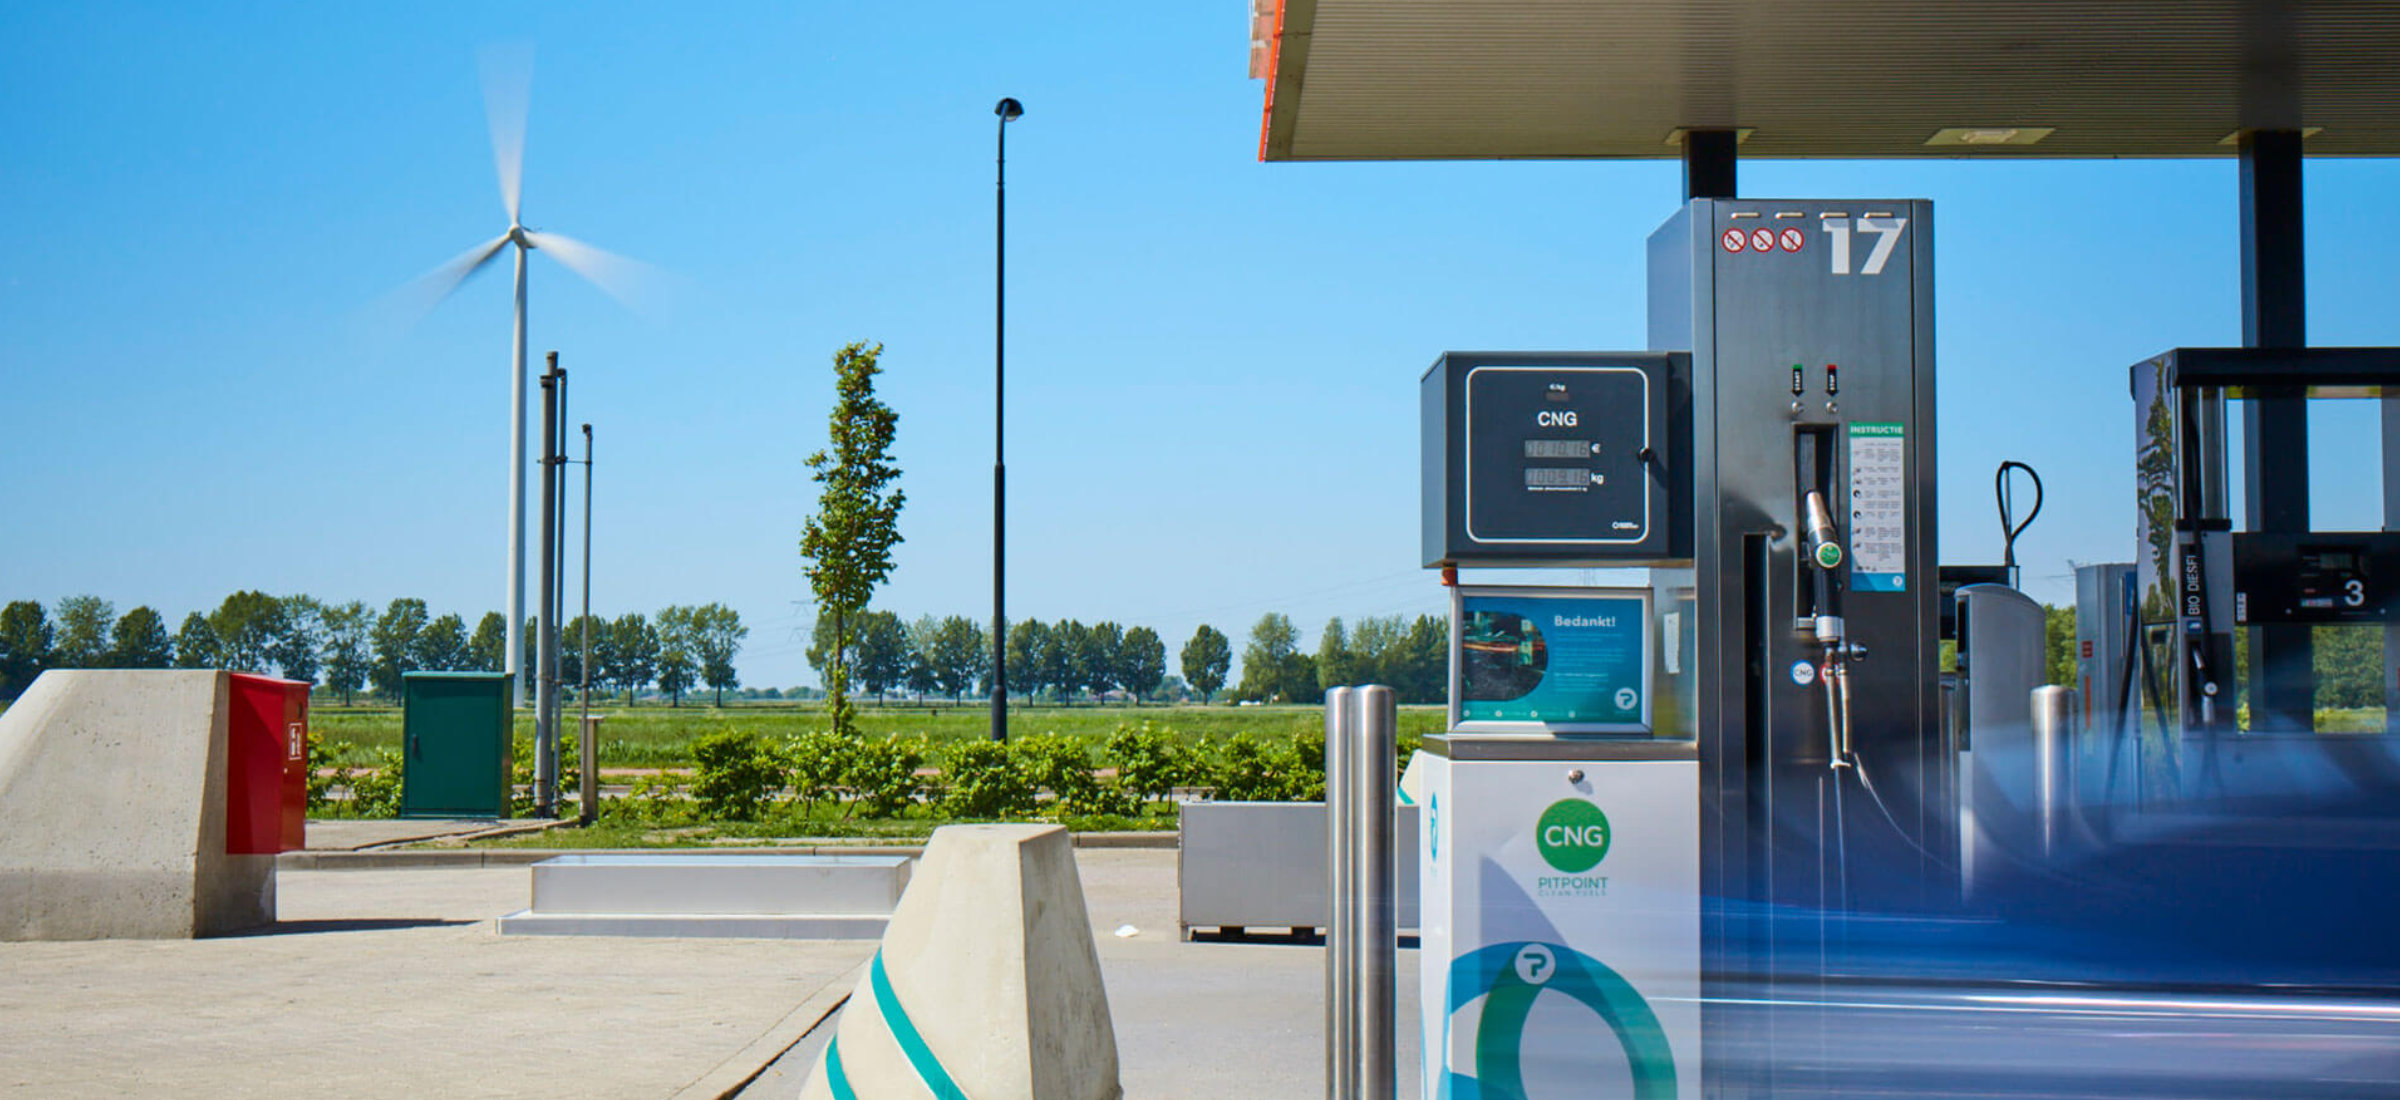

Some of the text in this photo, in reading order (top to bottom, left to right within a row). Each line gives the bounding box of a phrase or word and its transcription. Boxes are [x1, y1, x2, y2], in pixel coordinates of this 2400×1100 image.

[1821, 217, 1909, 275] 17
[1537, 411, 1578, 427] CNG
[1850, 425, 1904, 435] INSTRUCTIE
[1590, 471, 1604, 485] kg
[2343, 579, 2366, 607] 3
[2187, 595, 2201, 616] BIO
[1554, 614, 1616, 627] Bedankt!
[1793, 668, 1813, 677] CNG
[1544, 825, 1604, 848] CNG
[1537, 876, 1609, 889] PITPOINT
